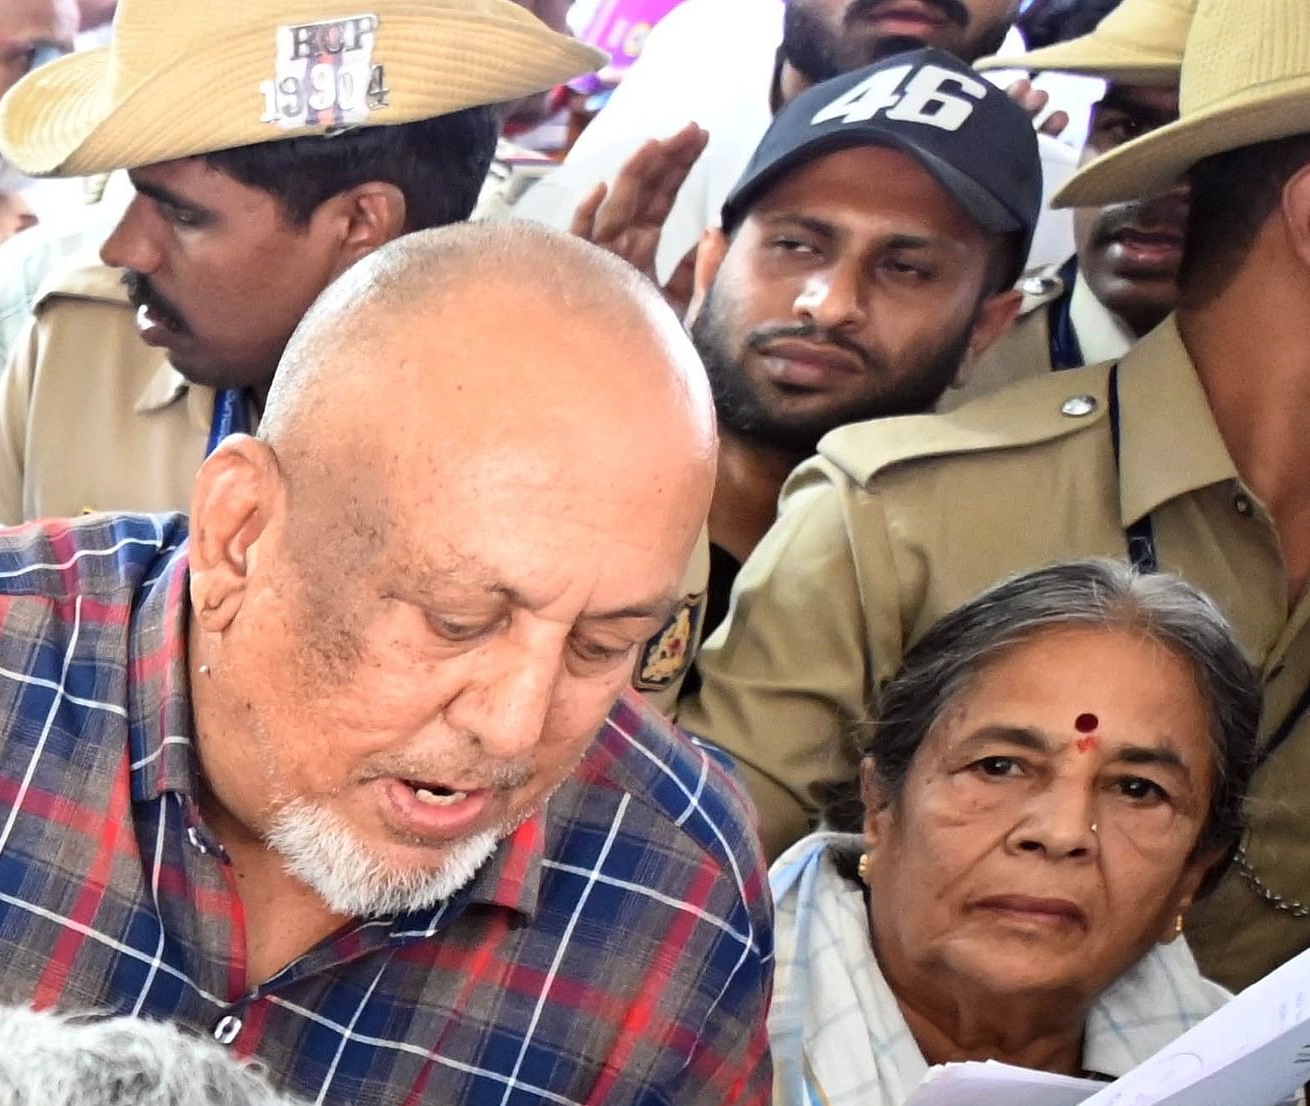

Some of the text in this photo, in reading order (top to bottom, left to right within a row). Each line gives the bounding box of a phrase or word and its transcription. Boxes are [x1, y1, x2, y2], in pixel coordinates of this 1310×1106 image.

[290, 15, 374, 60] BCP
[259, 64, 390, 122] 19904
[812, 63, 986, 131] 46
